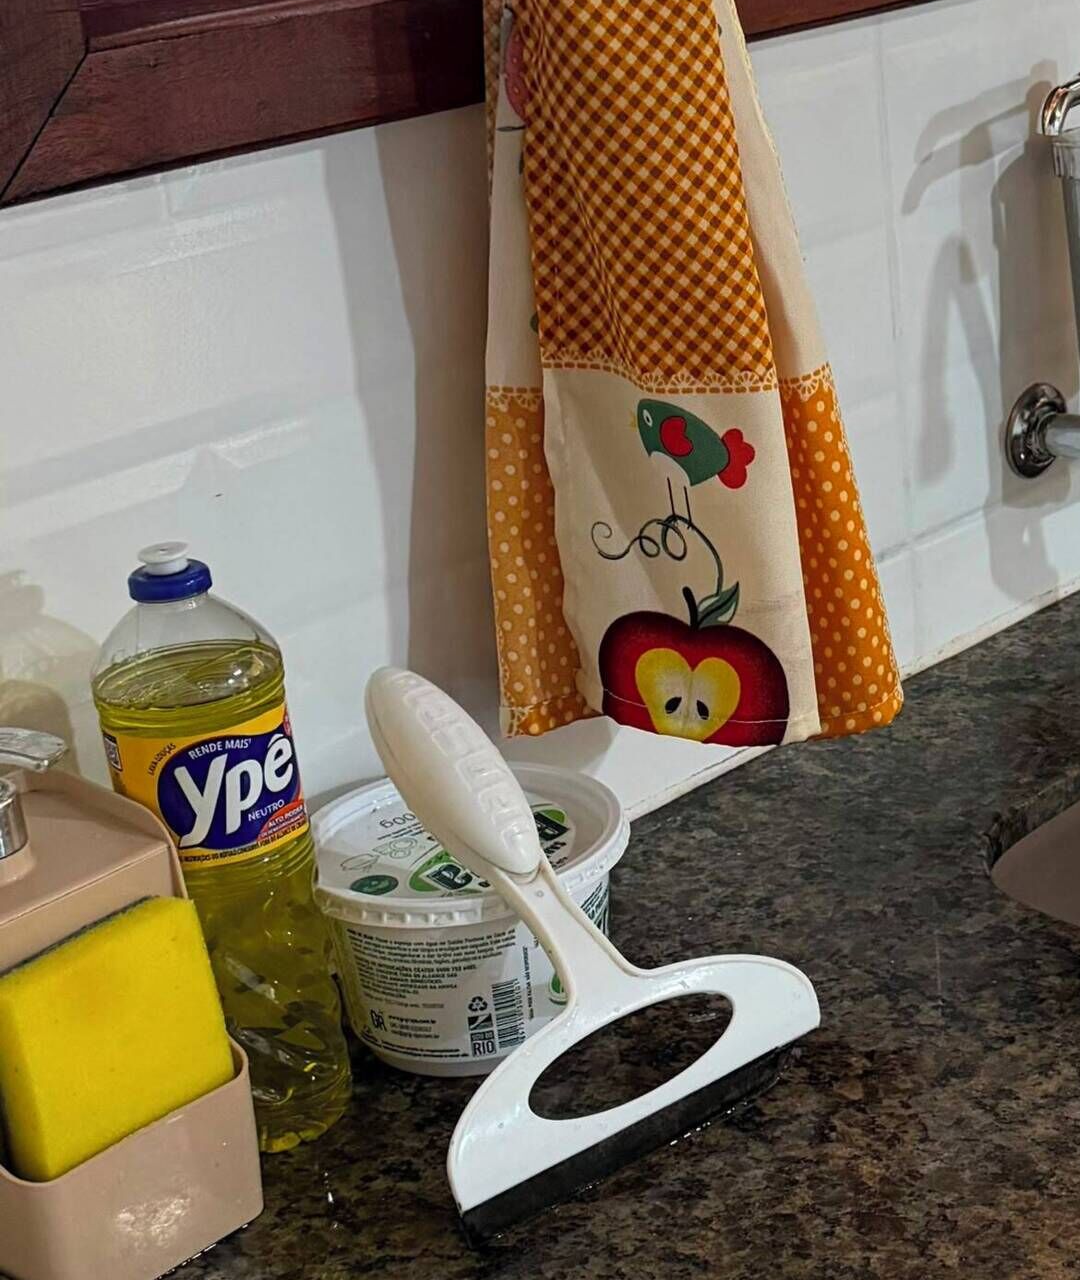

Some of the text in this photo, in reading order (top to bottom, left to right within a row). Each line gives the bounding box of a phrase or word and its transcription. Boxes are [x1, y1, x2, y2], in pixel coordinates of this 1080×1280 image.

[188, 742, 223, 760] RENDE
[173, 733, 293, 848] Ypê
[248, 799, 285, 821] NEUTRO
[472, 1040, 495, 1056] RIO
